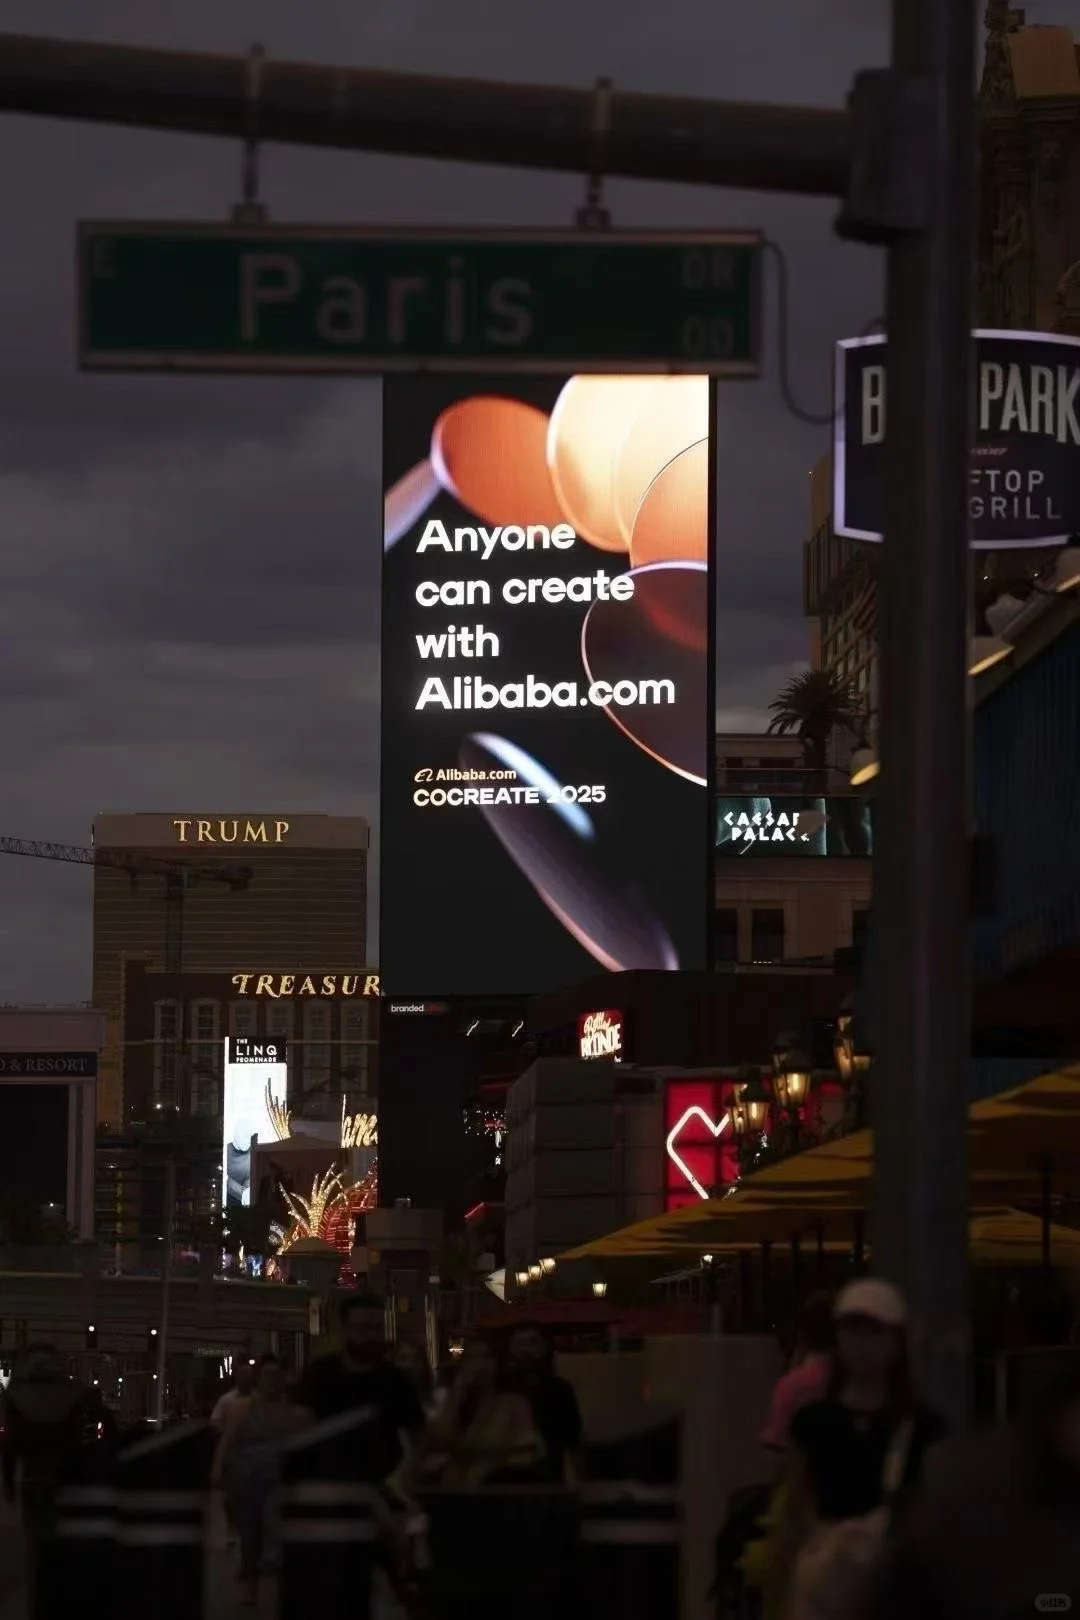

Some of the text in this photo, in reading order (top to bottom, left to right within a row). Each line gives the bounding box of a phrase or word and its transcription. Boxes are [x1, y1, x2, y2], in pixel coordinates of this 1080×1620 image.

[239, 252, 533, 346] Paris
[681, 250, 735, 289] DR
[979, 360, 1080, 446] PARK
[968, 496, 1062, 520] GRILL
[415, 519, 577, 560] Anyone
[415, 569, 635, 607] can create
[415, 624, 500, 659] with
[415, 675, 676, 711] Alibaba.com
[435, 768, 517, 781] Alibaba.com
[413, 787, 540, 807] COCREATE
[173, 820, 290, 843] TRUMP
[231, 974, 381, 999] TREASUR
[390, 1003, 425, 1013] branded
[236, 1044, 278, 1056] LINQ
[9, 1058, 22, 1072] &
[26, 1058, 88, 1072] RESORT
